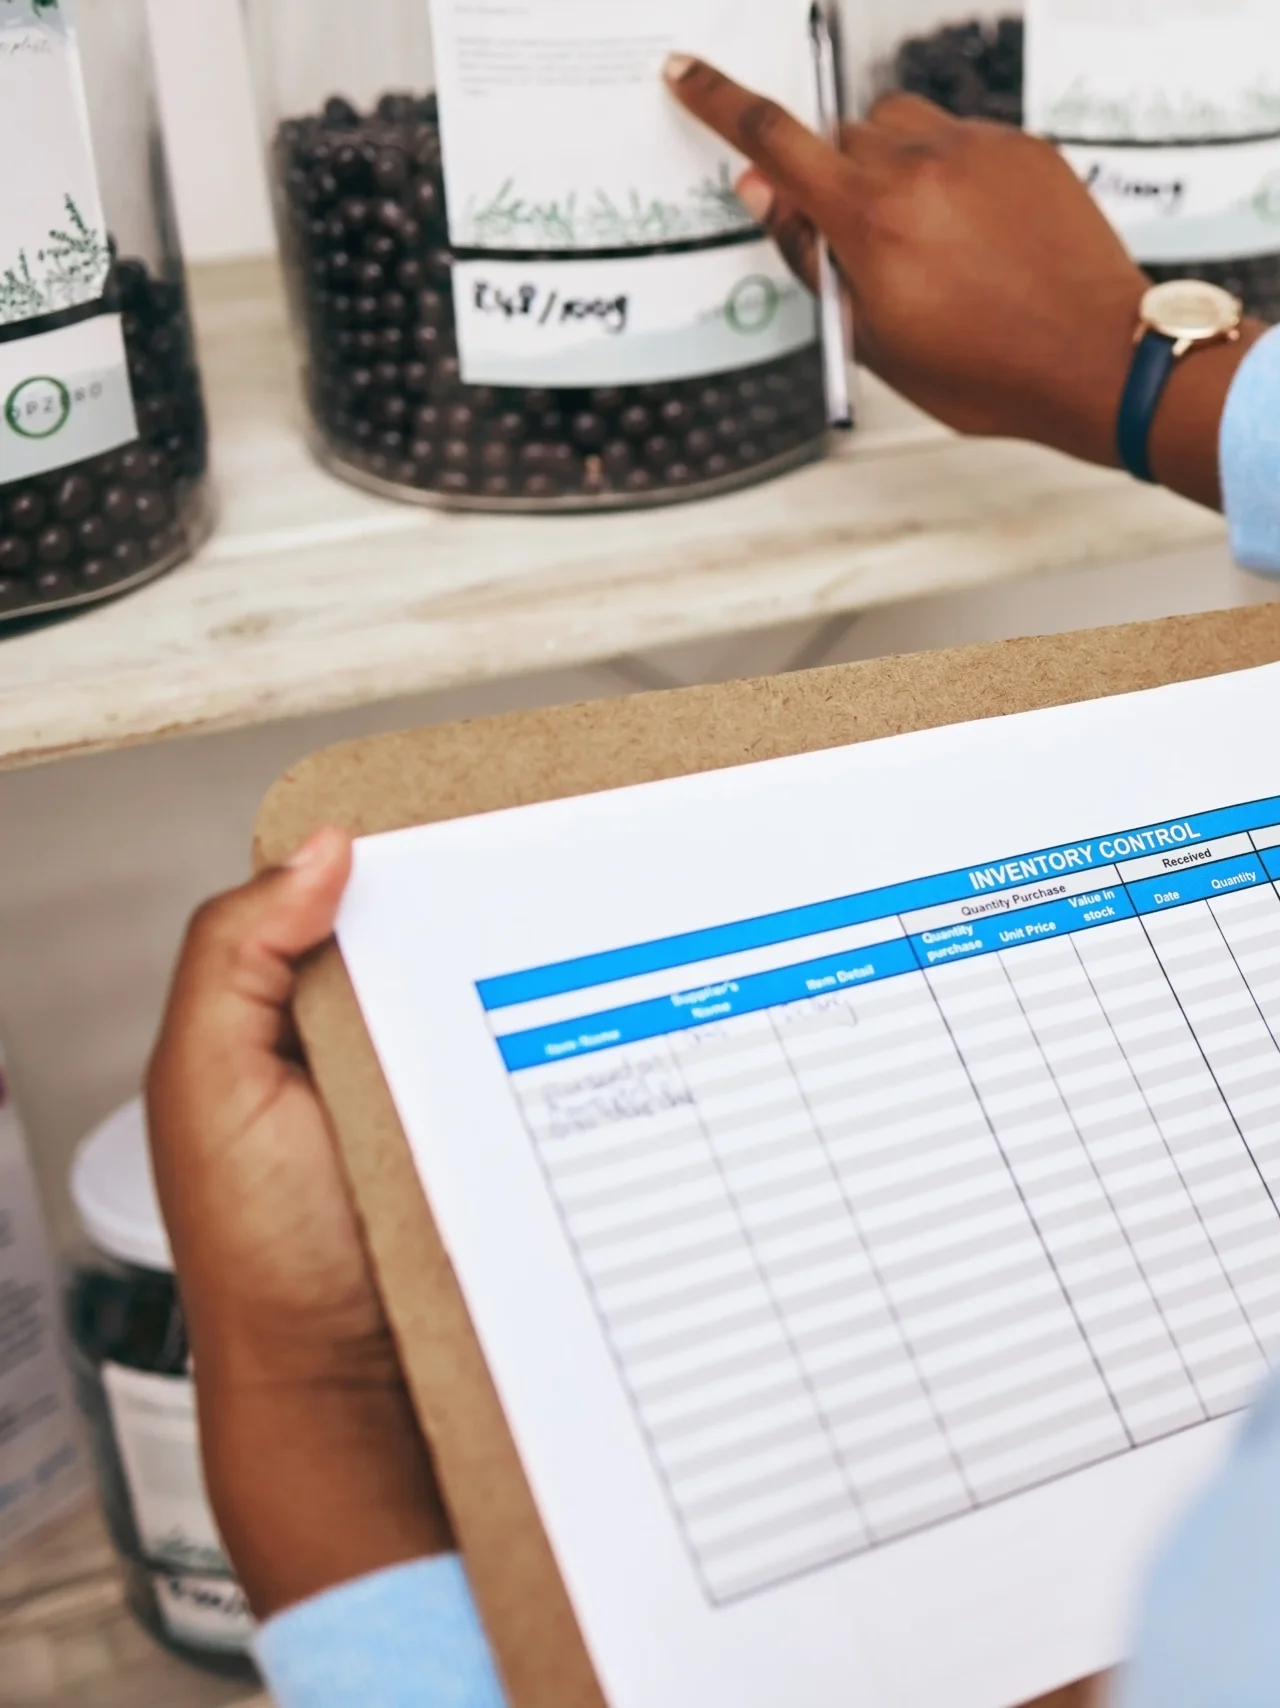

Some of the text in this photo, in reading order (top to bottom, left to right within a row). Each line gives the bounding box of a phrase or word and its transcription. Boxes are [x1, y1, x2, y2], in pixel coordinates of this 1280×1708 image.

[968, 822, 1201, 890] INVENTORY CONTROL
[1161, 847, 1213, 869] Received
[1211, 871, 1257, 890] Quantity
[961, 883, 1067, 918] Quantity Purchase
[1068, 889, 1116, 909] Value in
[1153, 889, 1181, 905] Date
[1083, 905, 1116, 923] stock
[921, 924, 974, 945] Quantity
[999, 920, 1057, 943] Unit Price
[926, 939, 984, 963] purchase
[805, 964, 876, 991] Item Detail
